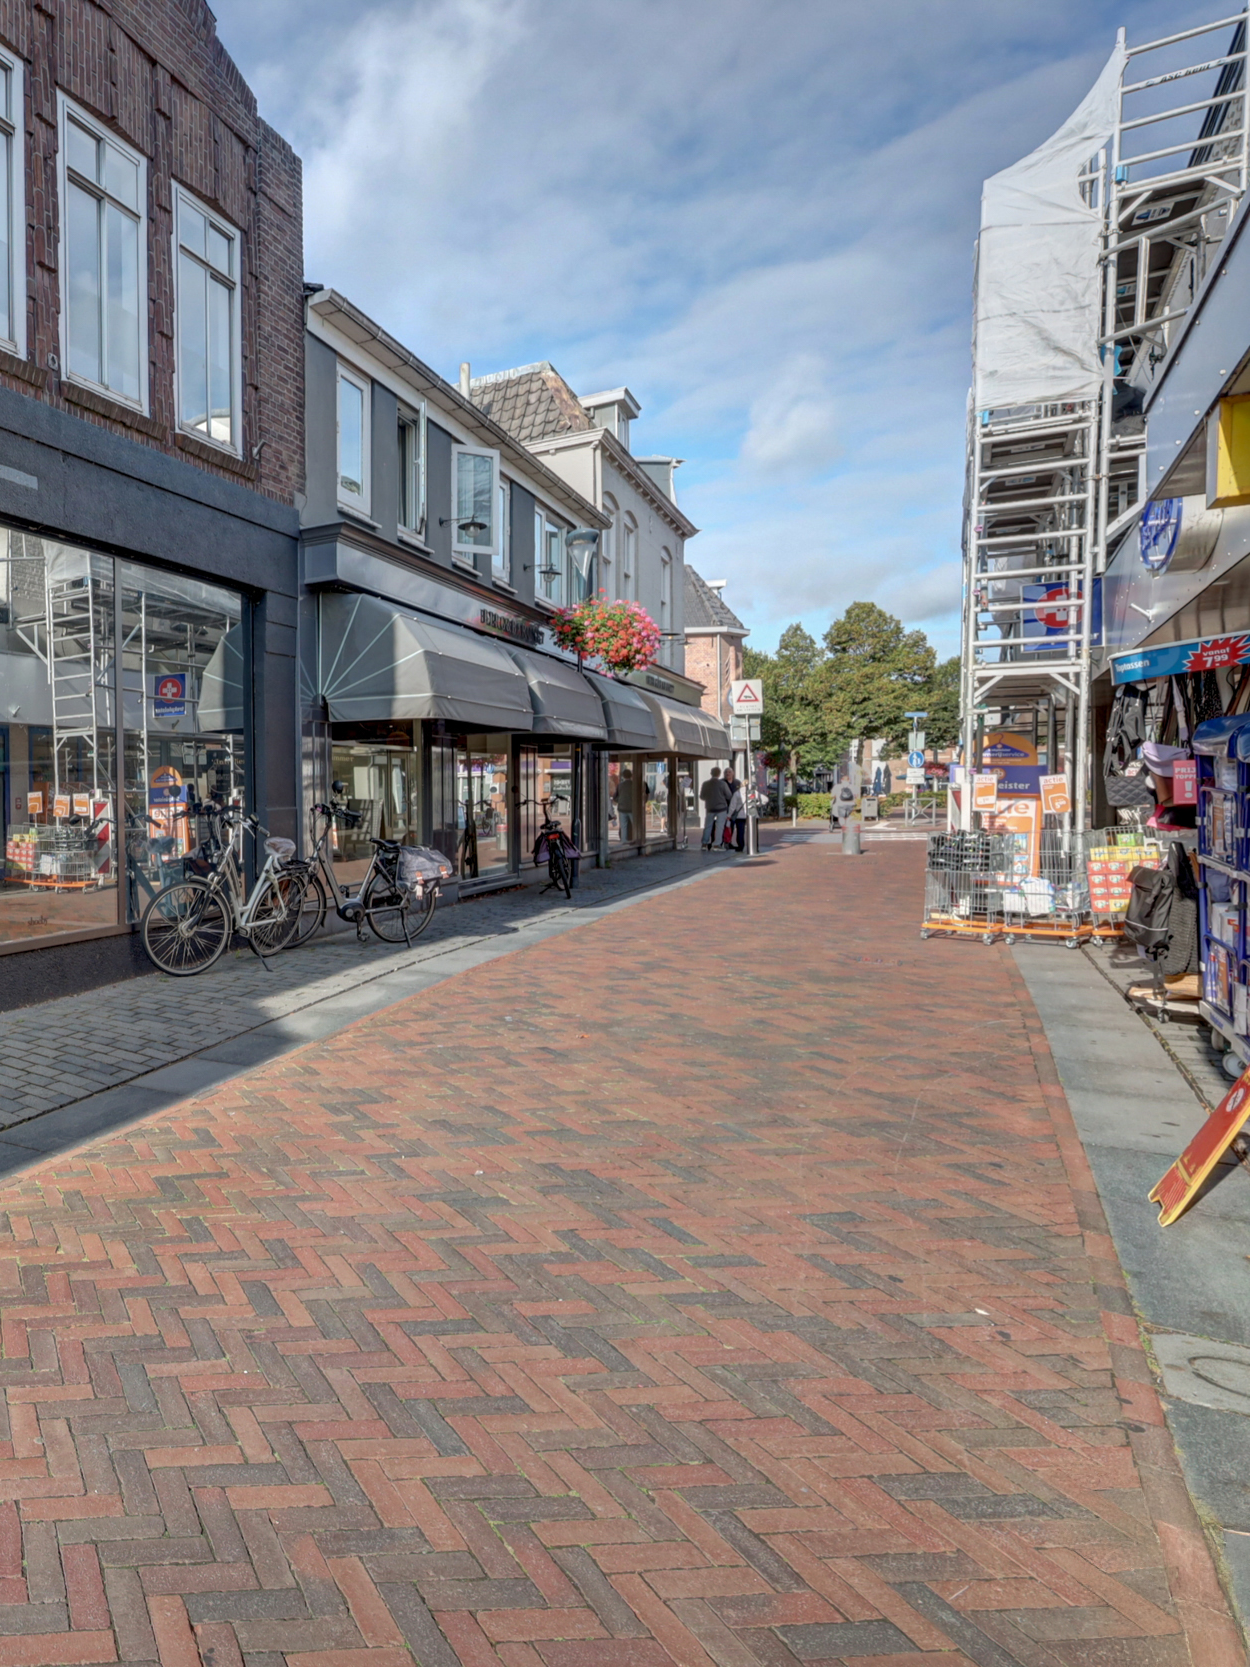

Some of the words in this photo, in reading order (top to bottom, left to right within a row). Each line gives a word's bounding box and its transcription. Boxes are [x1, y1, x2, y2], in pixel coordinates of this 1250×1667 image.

[1202, 647, 1230, 656] vanaf
[1115, 659, 1150, 673] Toptassen
[1043, 776, 1064, 784] actie
